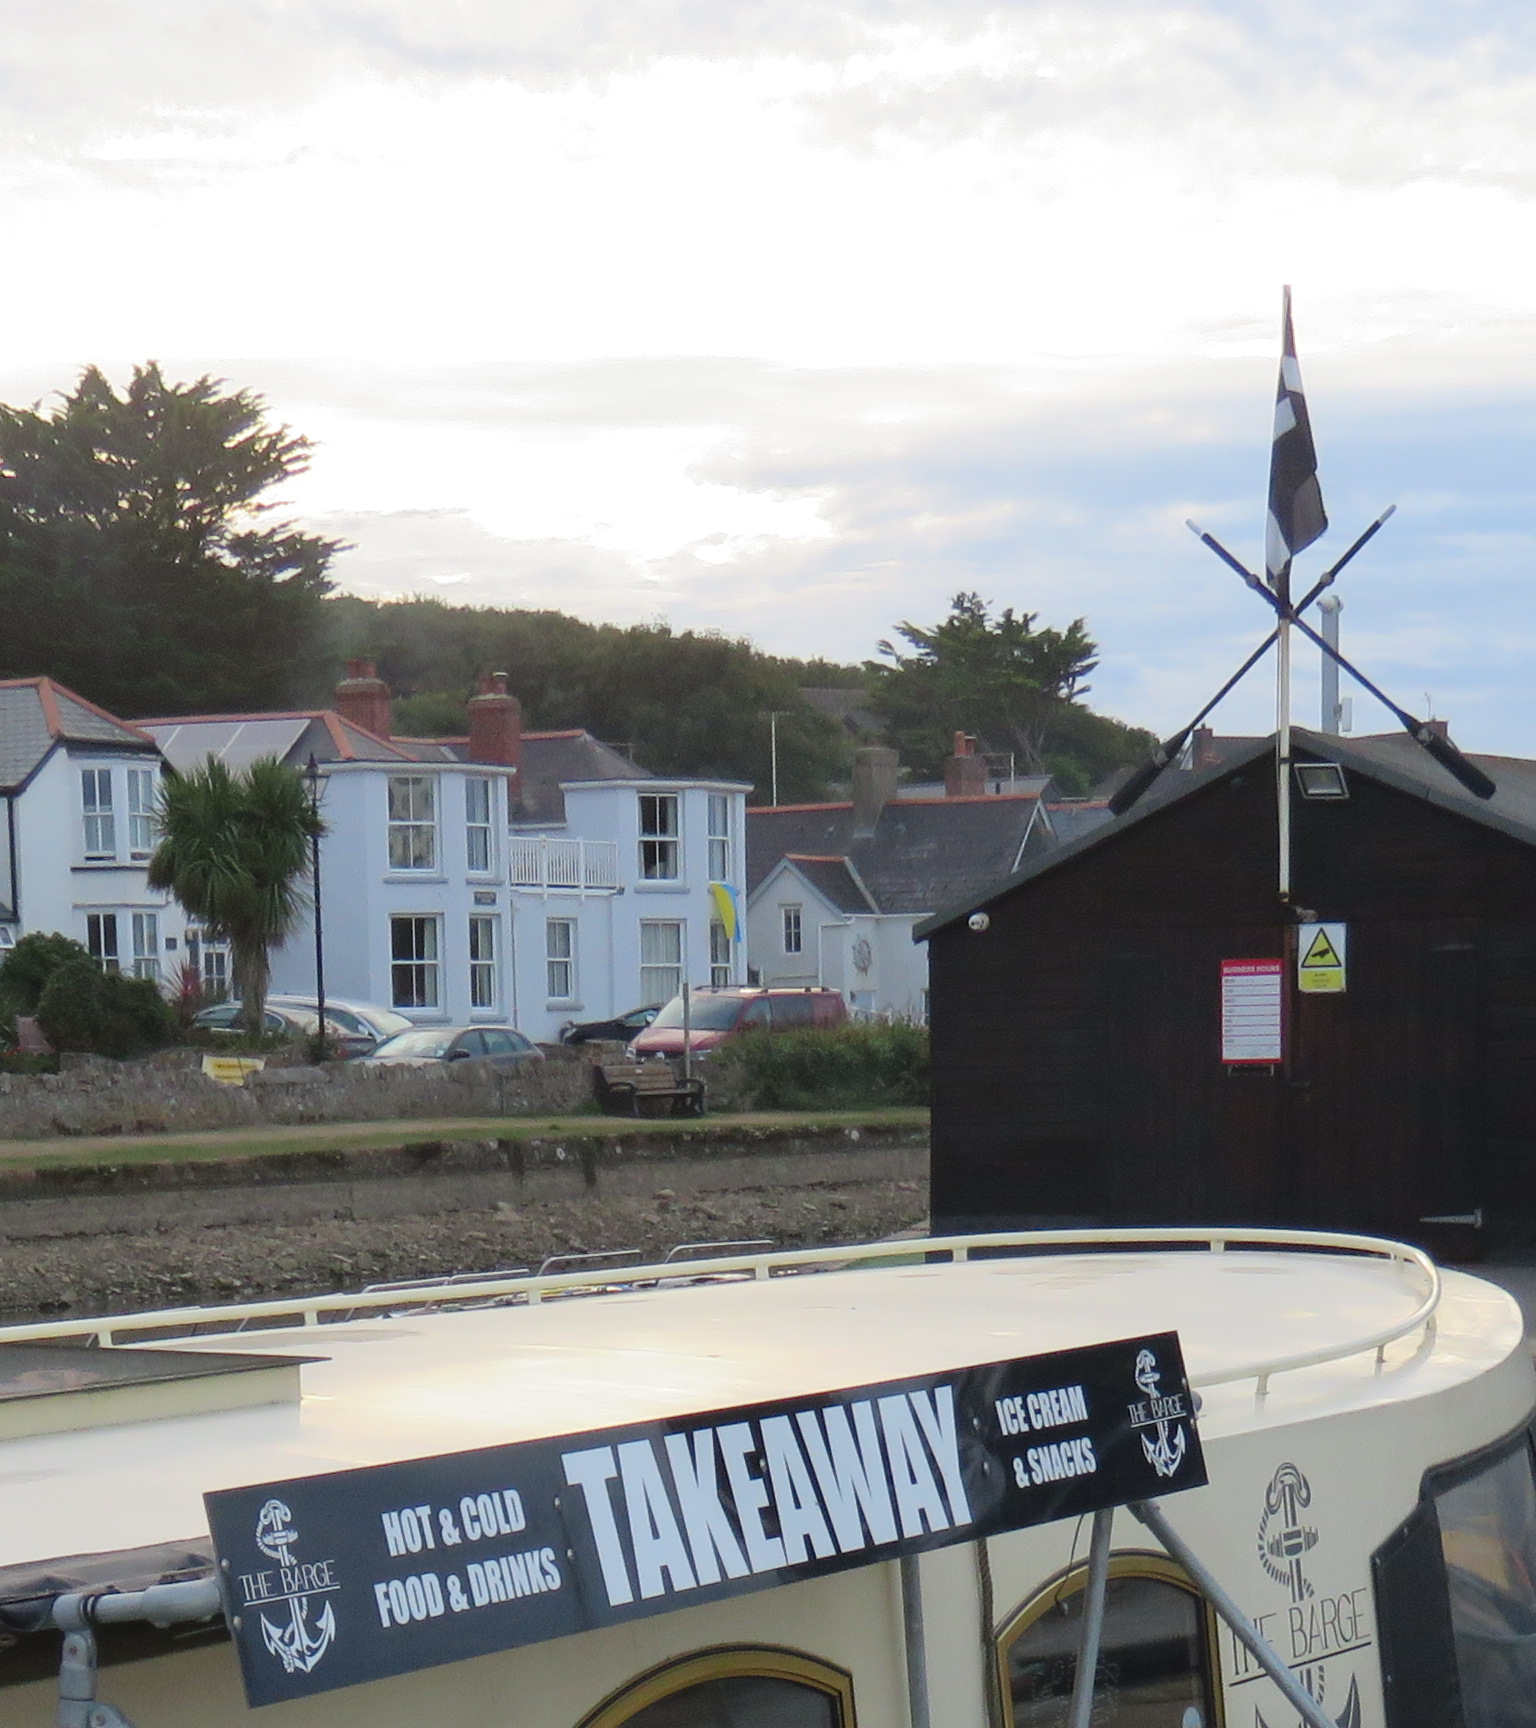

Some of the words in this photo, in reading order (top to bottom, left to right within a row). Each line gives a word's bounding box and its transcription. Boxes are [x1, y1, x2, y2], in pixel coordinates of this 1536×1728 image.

[995, 1393, 1030, 1437] ICE
[1027, 1385, 1089, 1431] CREAM
[1127, 1400, 1151, 1424] THE
[1150, 1393, 1187, 1419] BARGE
[1012, 1456, 1031, 1489] &
[1027, 1436, 1098, 1486] SNACKS
[381, 1504, 435, 1558] HOT
[439, 1507, 463, 1545] &
[459, 1488, 524, 1542] COLD
[562, 1385, 974, 1606] TAKEAWAY
[238, 1571, 278, 1600] THE
[279, 1559, 340, 1593] BARGE
[373, 1570, 445, 1628] FOOD
[449, 1573, 474, 1611] &
[467, 1546, 562, 1605] DRINKS
[1288, 1587, 1371, 1660] BARGE
